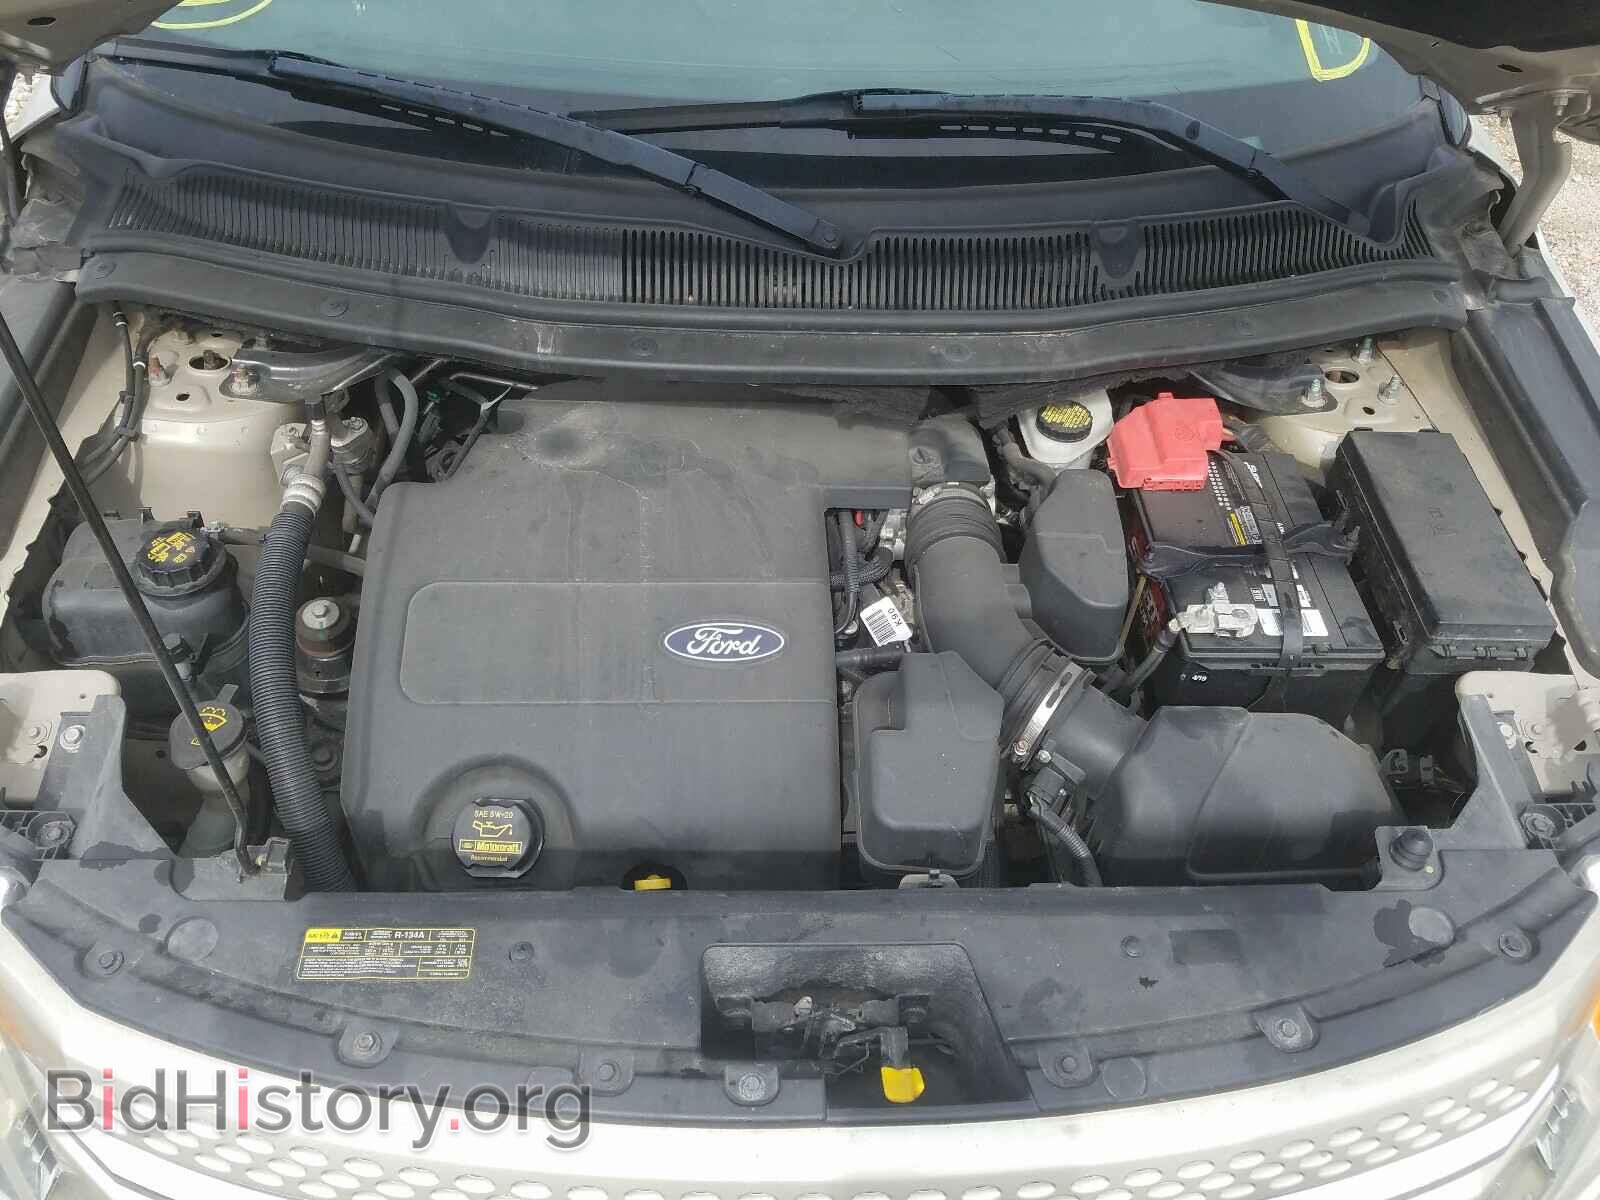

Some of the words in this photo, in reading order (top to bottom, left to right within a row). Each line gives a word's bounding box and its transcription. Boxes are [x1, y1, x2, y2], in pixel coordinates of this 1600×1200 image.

[686, 627, 762, 655] Ford
[474, 810, 489, 818] SAE
[394, 931, 425, 939] R-134A
